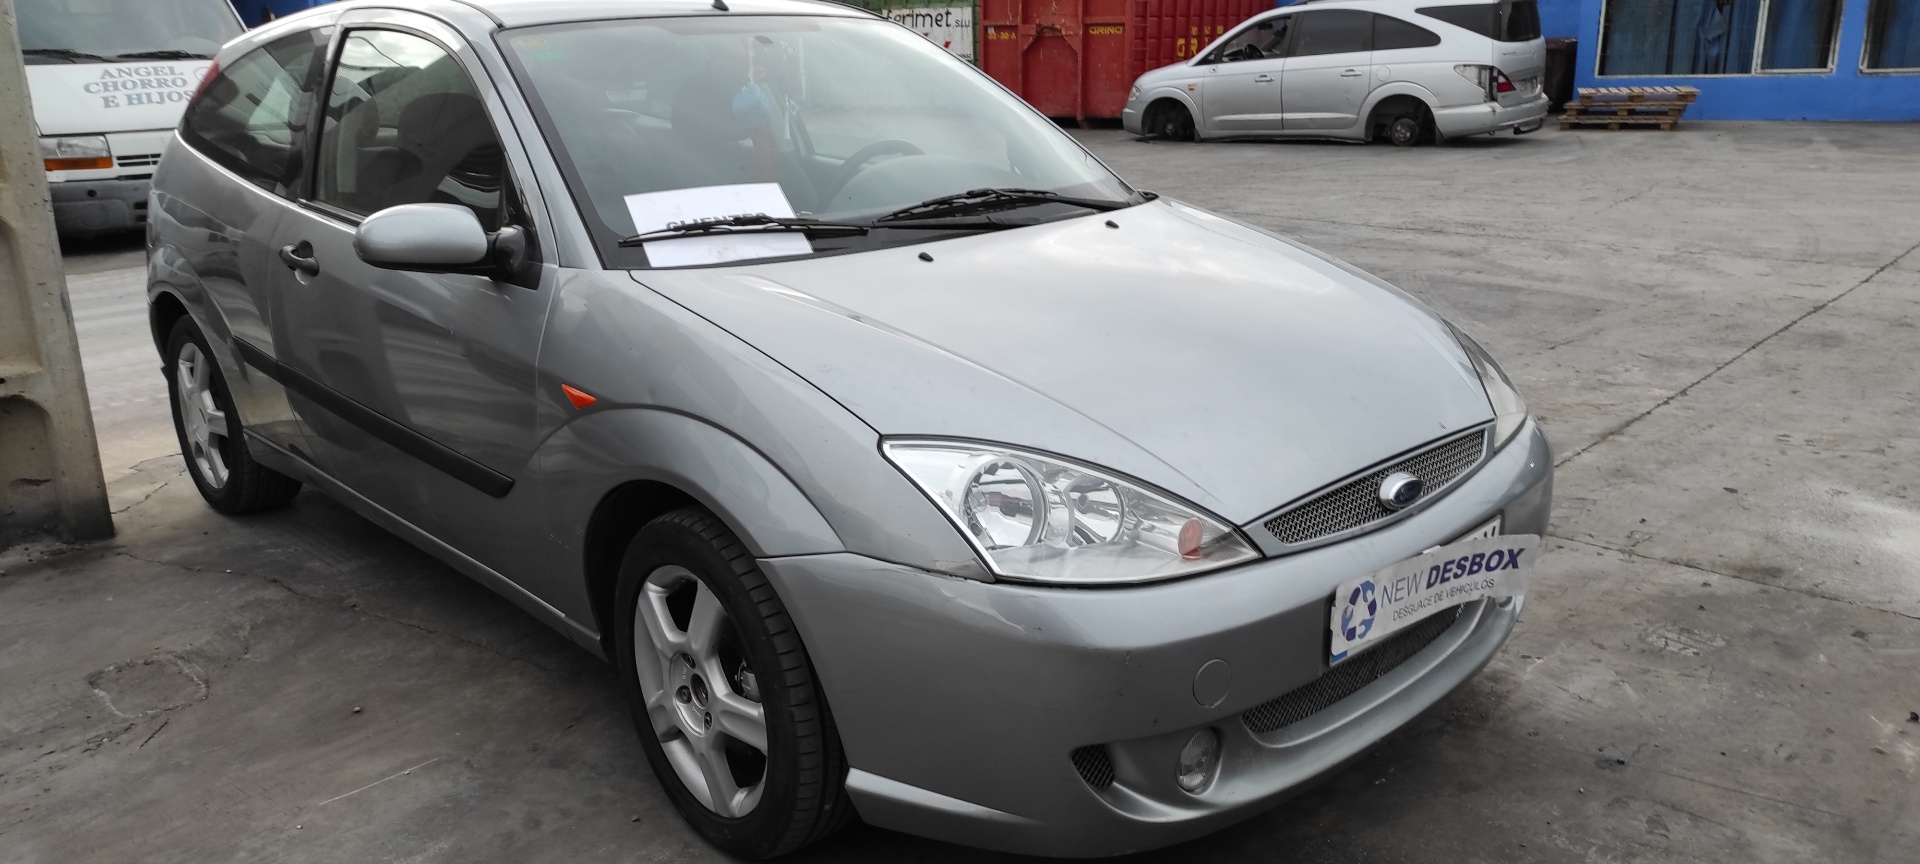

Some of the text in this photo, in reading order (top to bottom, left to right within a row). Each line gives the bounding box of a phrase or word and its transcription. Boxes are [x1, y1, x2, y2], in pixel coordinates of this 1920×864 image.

[100, 66, 184, 80] ANGEL
[83, 77, 188, 94] CHORRO
[101, 90, 195, 109] E HIJOS
[1381, 547, 1526, 609] NEW DESBOX
[1392, 596, 1433, 621] DESGUACE
